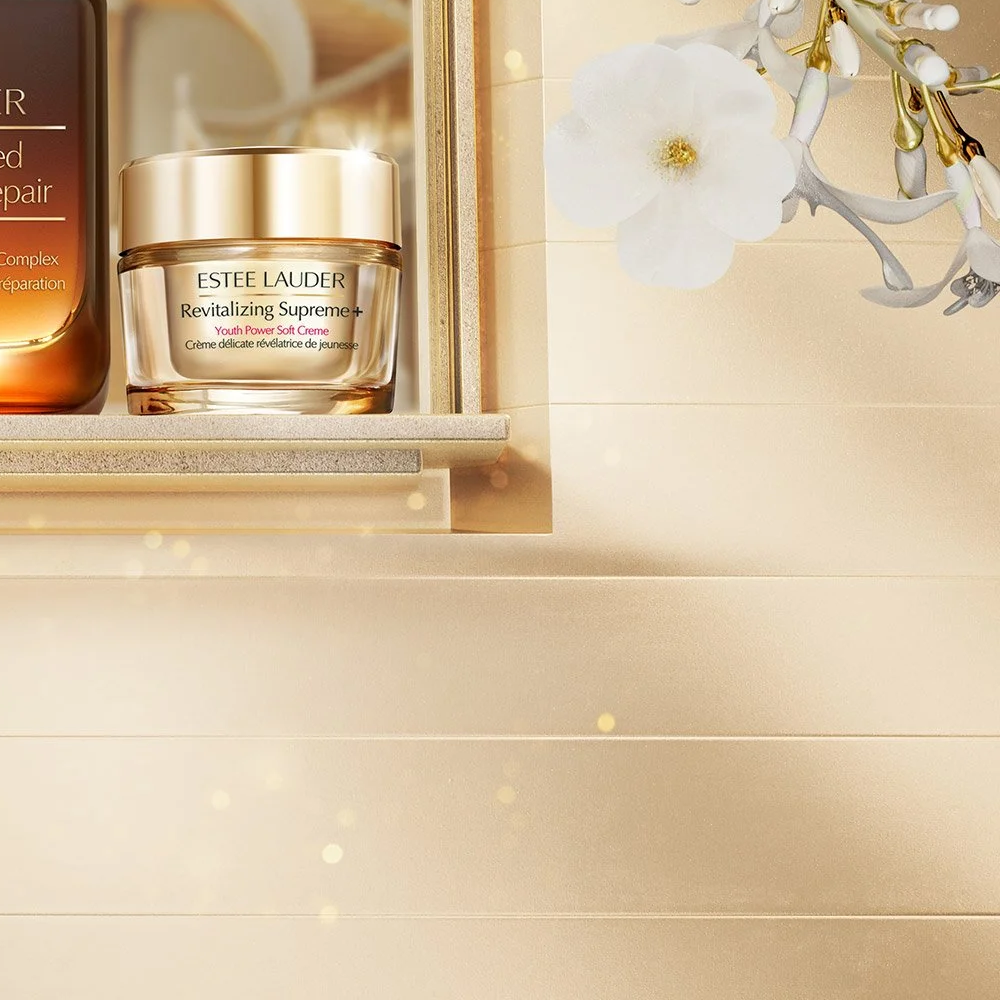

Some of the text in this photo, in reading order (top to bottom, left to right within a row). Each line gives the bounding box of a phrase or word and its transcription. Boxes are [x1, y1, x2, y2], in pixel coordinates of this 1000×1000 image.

[264, 272, 345, 289] LAUDER
[181, 302, 274, 321] Revitalizing
[215, 326, 329, 336] Youth Power Soft Creme
[185, 338, 359, 351] Crème délicate révélatrice de jeunesse
